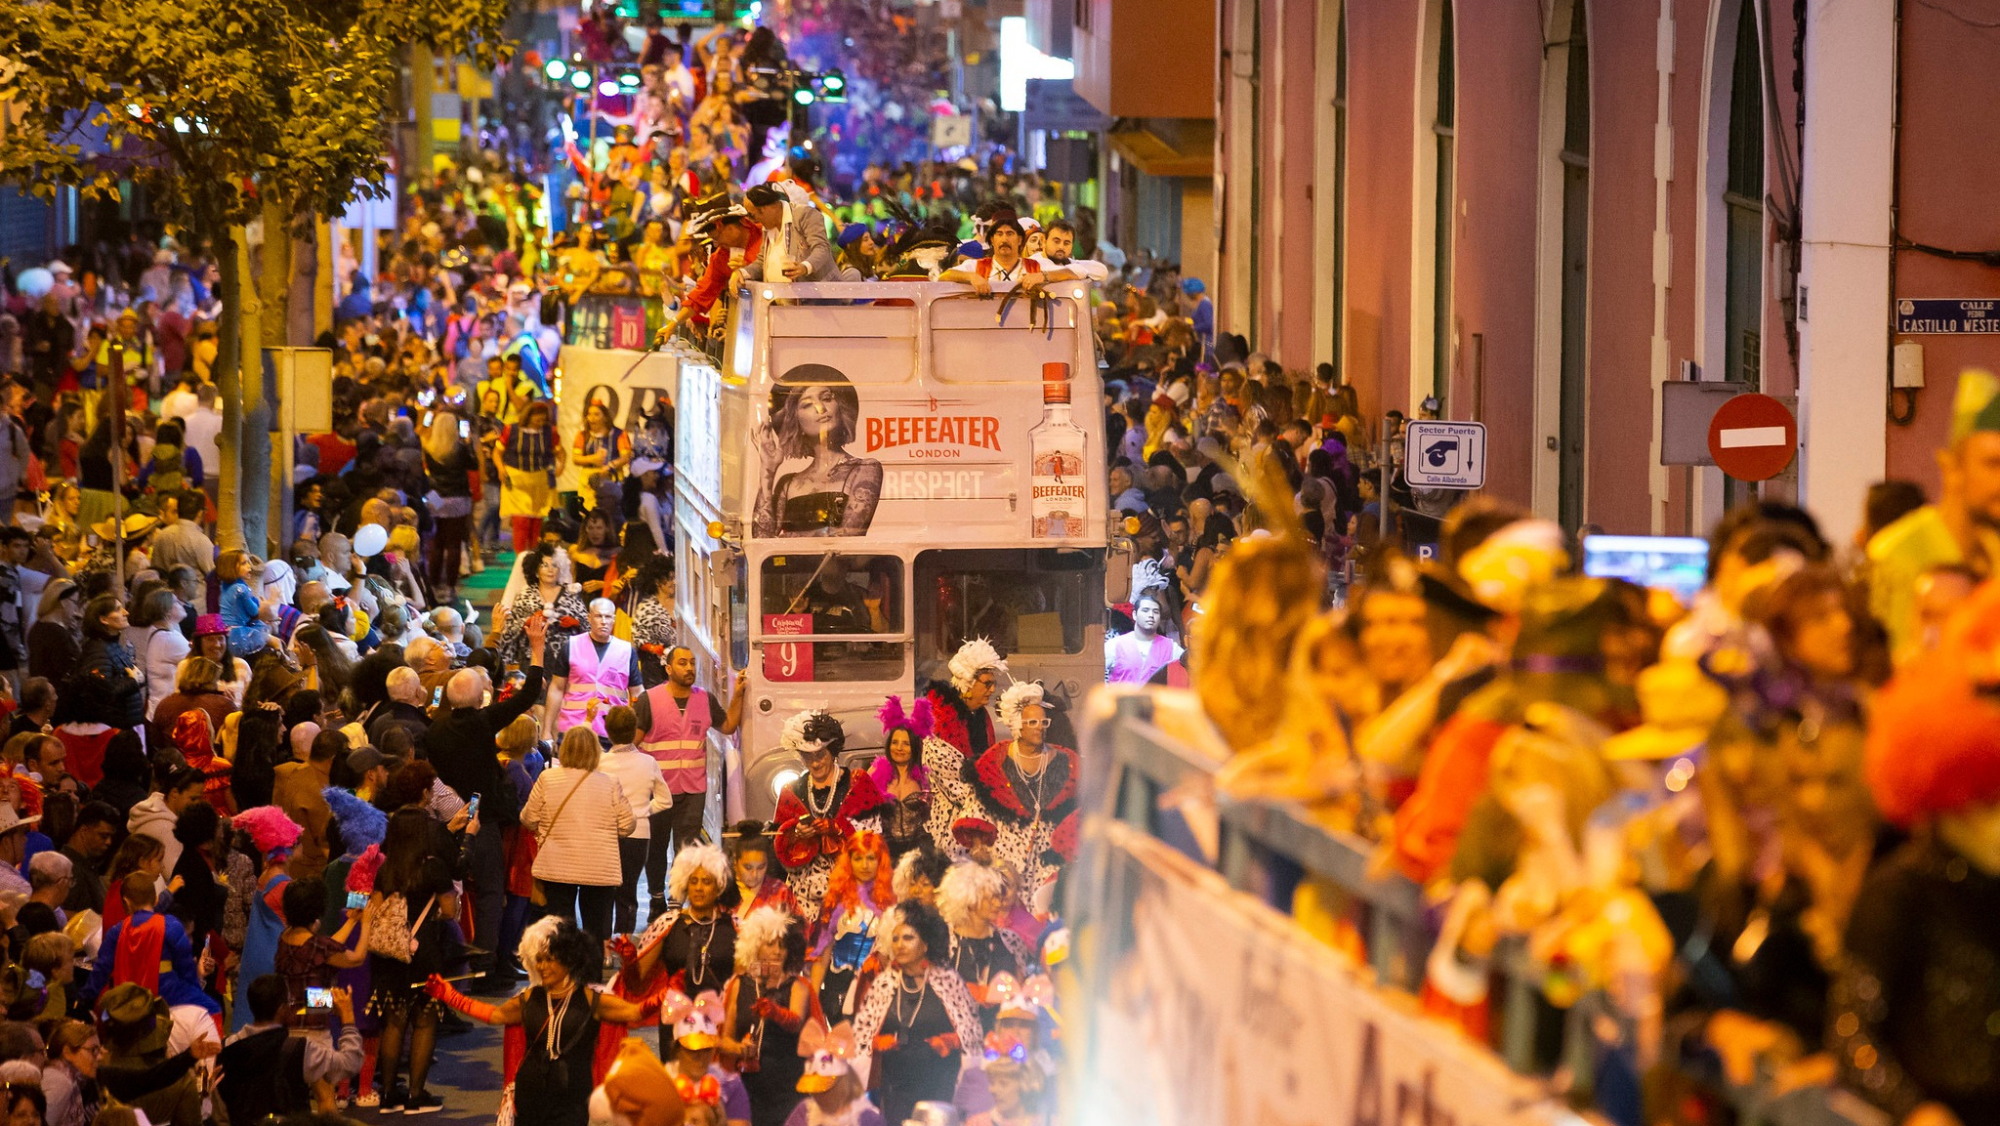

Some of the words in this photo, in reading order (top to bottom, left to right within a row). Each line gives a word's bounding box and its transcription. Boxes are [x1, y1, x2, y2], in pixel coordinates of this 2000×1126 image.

[1960, 301, 1995, 310] CALLE
[1903, 319, 1957, 332] CASTILLO
[621, 321, 638, 347] 10
[866, 416, 1002, 453] BEEFEATER
[1418, 426, 1446, 434] Sector
[1448, 427, 1476, 435] Puerto
[908, 449, 961, 458] LONDON
[1426, 475, 1441, 483] Calle
[1032, 485, 1086, 499] BEEFEATER
[1419, 545, 1433, 563] P
[780, 642, 797, 677] 9
